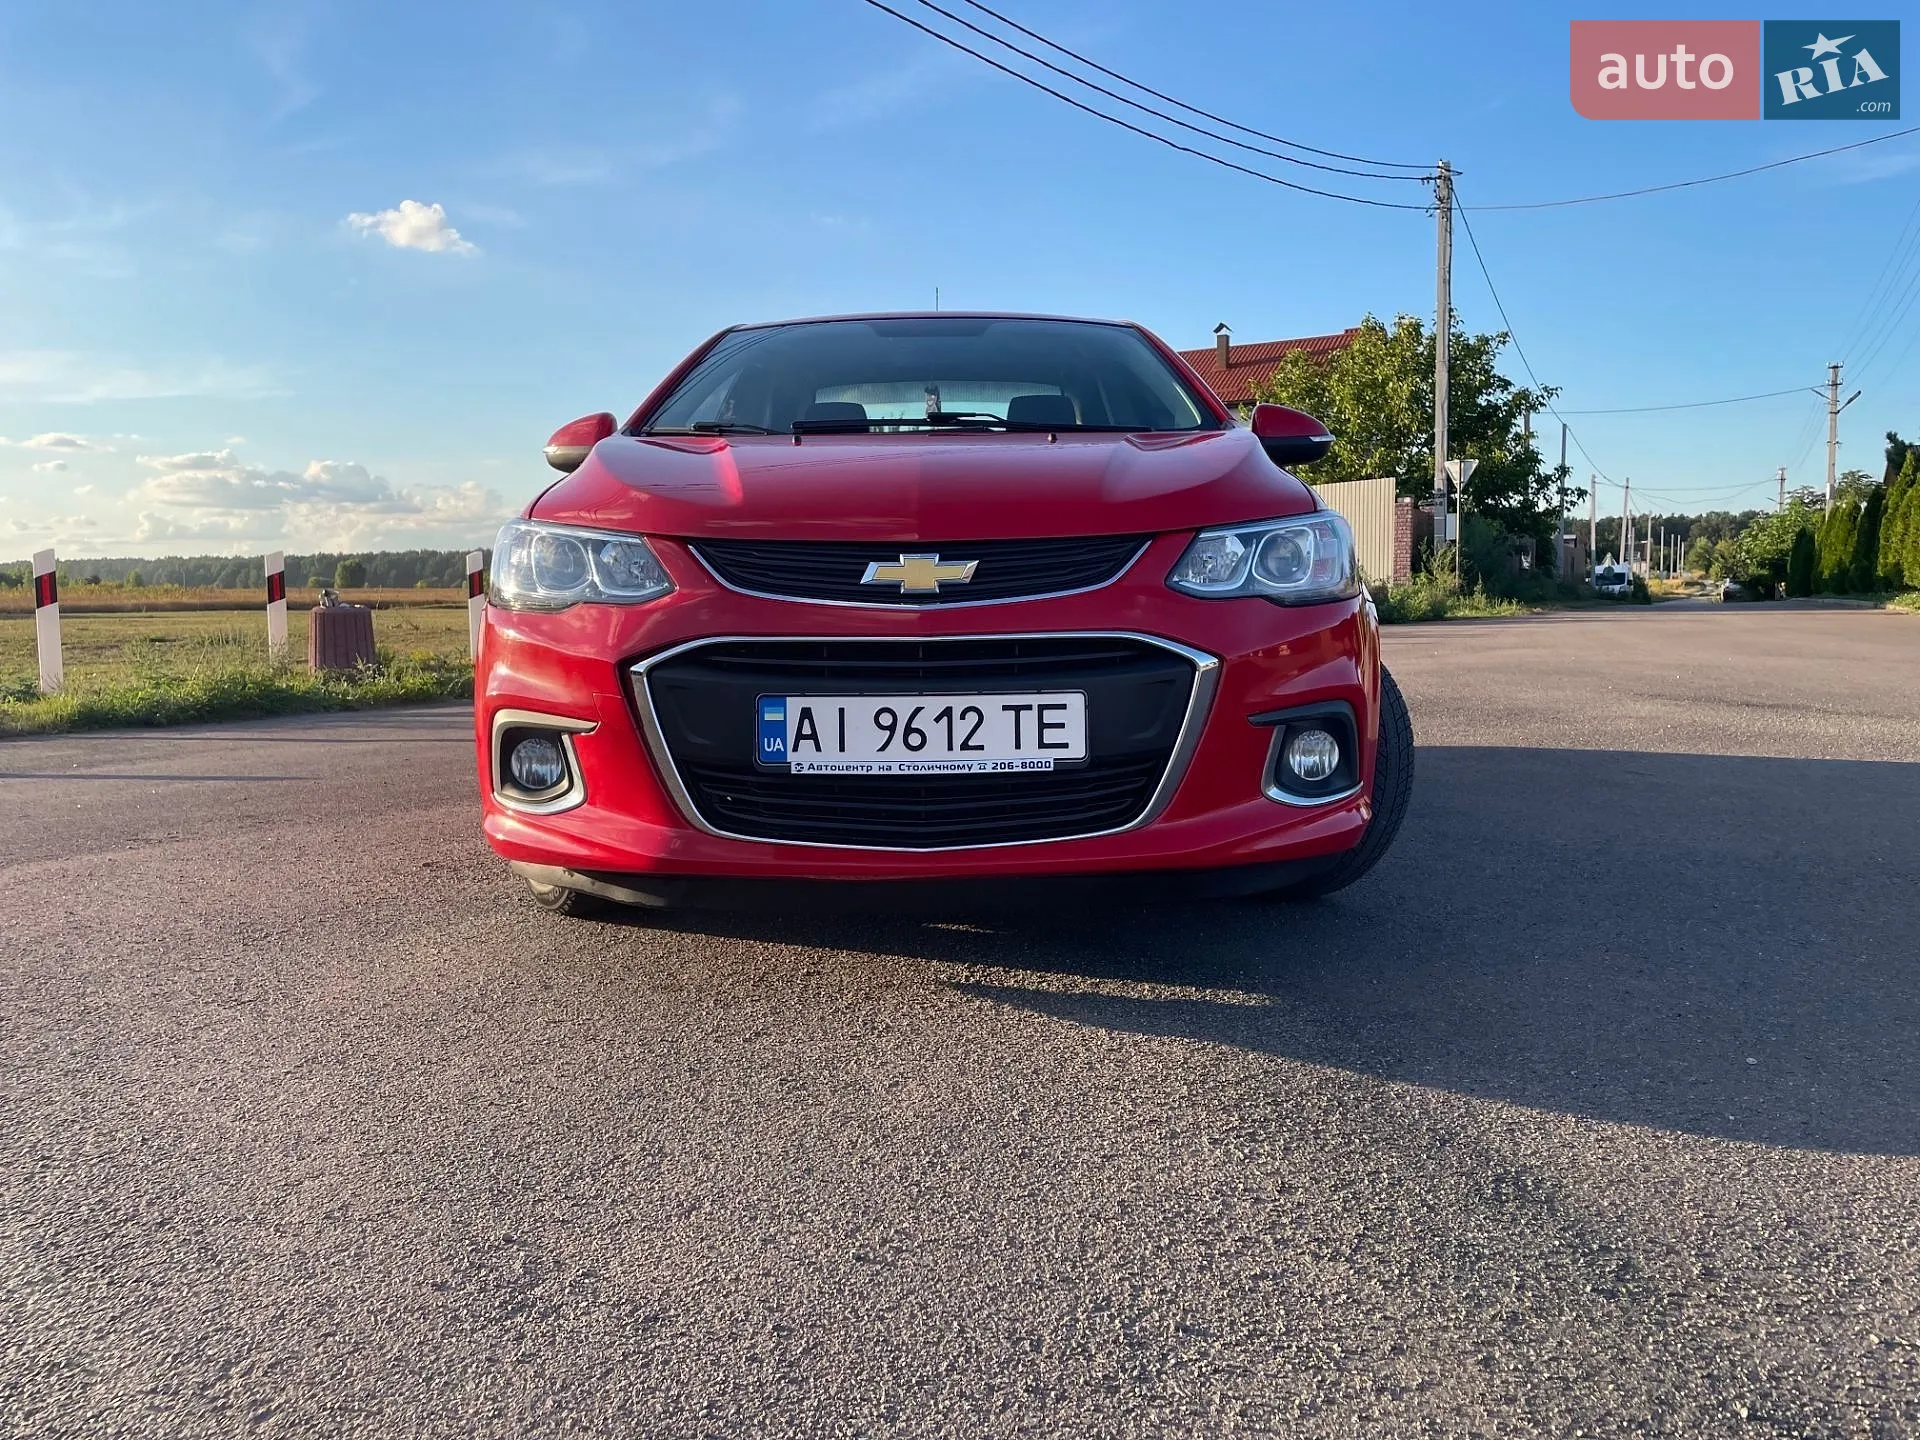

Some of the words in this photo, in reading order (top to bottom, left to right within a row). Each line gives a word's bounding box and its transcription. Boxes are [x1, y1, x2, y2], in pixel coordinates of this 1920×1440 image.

[791, 706, 846, 753] AI
[873, 705, 985, 752] 9612
[1001, 703, 1070, 750] TE
[764, 737, 785, 752] UA
[807, 762, 873, 773] Автоцентр
[878, 763, 892, 772] на
[898, 762, 974, 773] Столичному
[991, 760, 1052, 771] 206-8000
